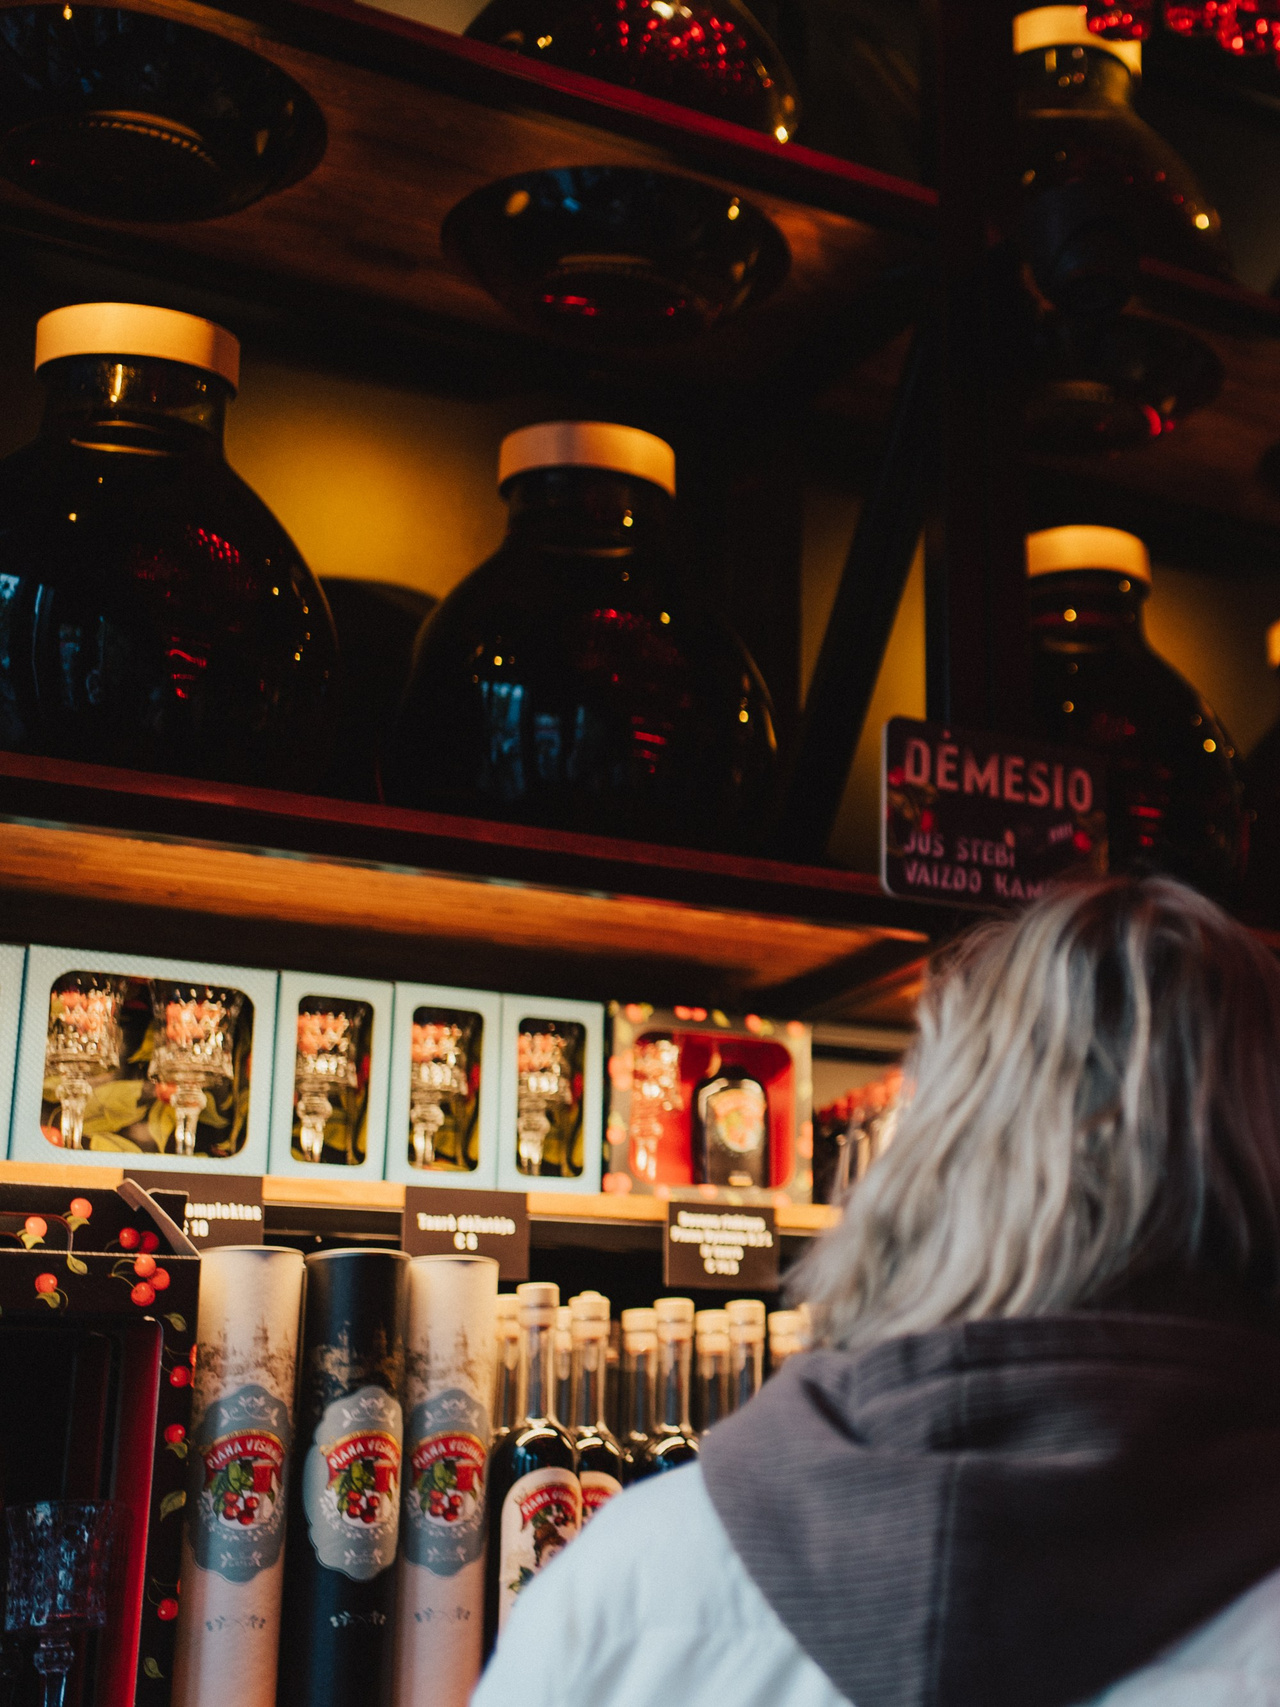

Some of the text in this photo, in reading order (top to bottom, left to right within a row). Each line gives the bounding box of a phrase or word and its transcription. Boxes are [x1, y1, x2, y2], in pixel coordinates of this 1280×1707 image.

[904, 730, 1093, 812] DĖMESIO
[904, 859, 1044, 900] VAIZDO KAM
[185, 1202, 262, 1221] omplektas
[206, 1440, 243, 1469] PIANA
[329, 1441, 366, 1469] PIANA
[412, 1440, 448, 1469] PIANA
